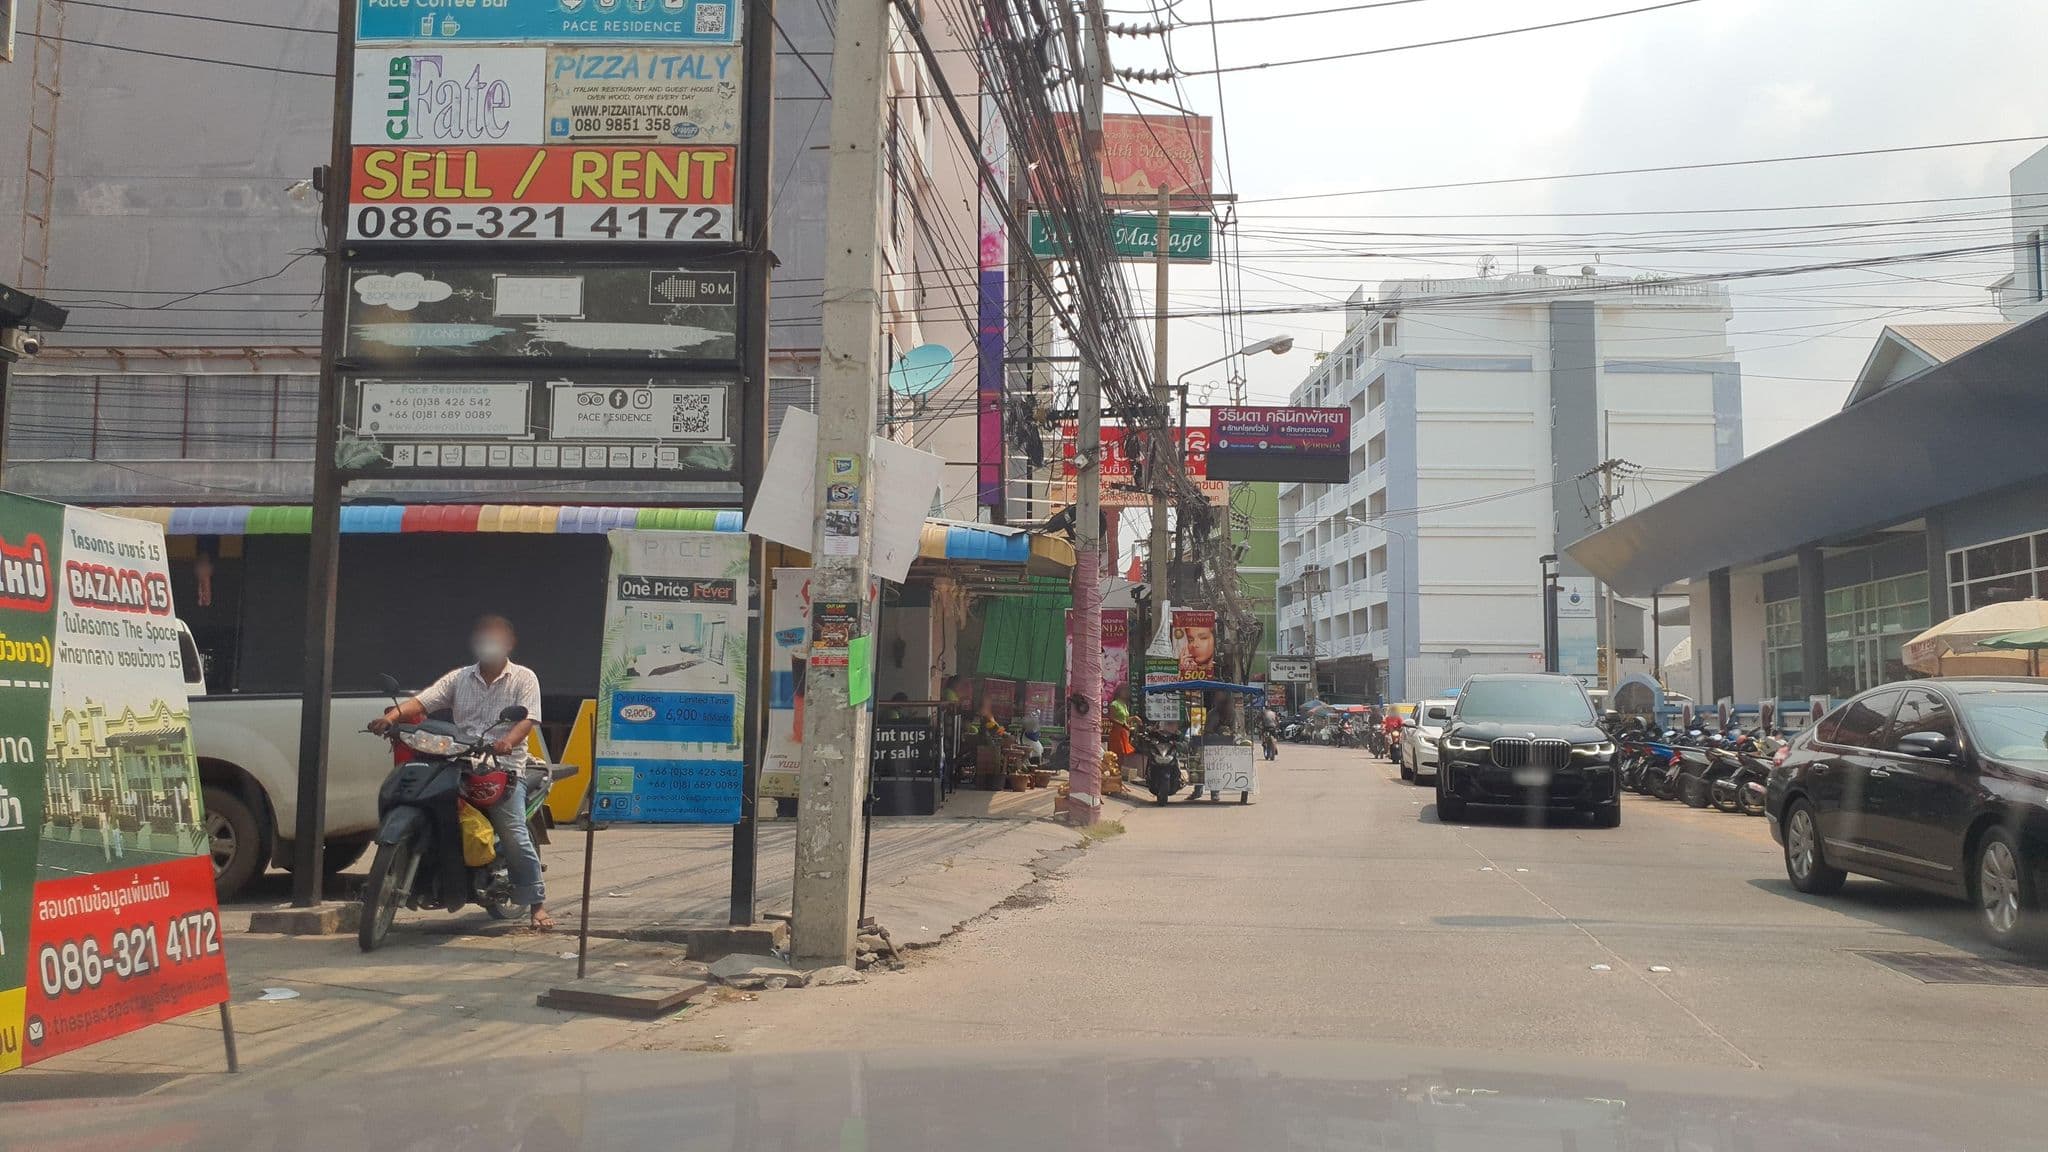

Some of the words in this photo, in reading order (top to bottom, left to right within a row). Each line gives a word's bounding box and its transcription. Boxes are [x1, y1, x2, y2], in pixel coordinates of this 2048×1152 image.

[563, 20, 597, 32] PACE
[604, 21, 682, 32] RESIDENCE
[554, 54, 640, 80] PIZZA
[648, 54, 732, 80] ITALY
[386, 55, 411, 140] CLUB
[404, 55, 511, 139] Fate
[571, 105, 689, 117] WWW.PIZZAITALYTK.COM
[575, 118, 601, 132] 080
[605, 118, 639, 132] 9851
[645, 118, 671, 132] 358
[361, 150, 493, 200] SELL
[512, 149, 547, 200] /
[571, 150, 728, 200] RENT
[357, 206, 566, 239] 086-321
[589, 207, 722, 239] 4172
[1114, 226, 1202, 253] Masage
[700, 282, 715, 294] 50
[718, 283, 732, 294] M.
[401, 385, 428, 394] Pace
[432, 385, 489, 395] Residence
[390, 398, 409, 406] +66
[412, 398, 440, 408] (0)38
[445, 398, 465, 406] 426
[469, 398, 491, 406] 542
[389, 411, 408, 419] +66
[412, 411, 437, 420] (0)81
[440, 411, 461, 419] 689
[465, 411, 492, 419] 0089
[577, 413, 601, 422] PACE
[1217, 407, 1261, 422] วีรินดา
[1266, 409, 1344, 424] คลินิกพัทยา
[71, 529, 115, 555] โครงการ
[148, 544, 160, 561] 15
[645, 540, 711, 557] PCE
[0, 548, 46, 598] หม่
[70, 569, 144, 606] BAZAAR
[148, 580, 168, 608] 15
[622, 580, 650, 596] One
[654, 581, 689, 597] Price
[693, 582, 733, 598] Fever
[63, 611, 120, 637] ในโครงการ
[122, 619, 142, 639] The
[146, 621, 177, 644] Space
[168, 650, 181, 669] 15
[666, 708, 698, 721] 6,900
[890, 745, 920, 759] sale
[1222, 771, 1249, 790] 25
[39, 873, 170, 920] สอบถามข้อมูลเพิ่มเติม
[40, 925, 160, 995] 086-321
[166, 911, 219, 961] 4172
